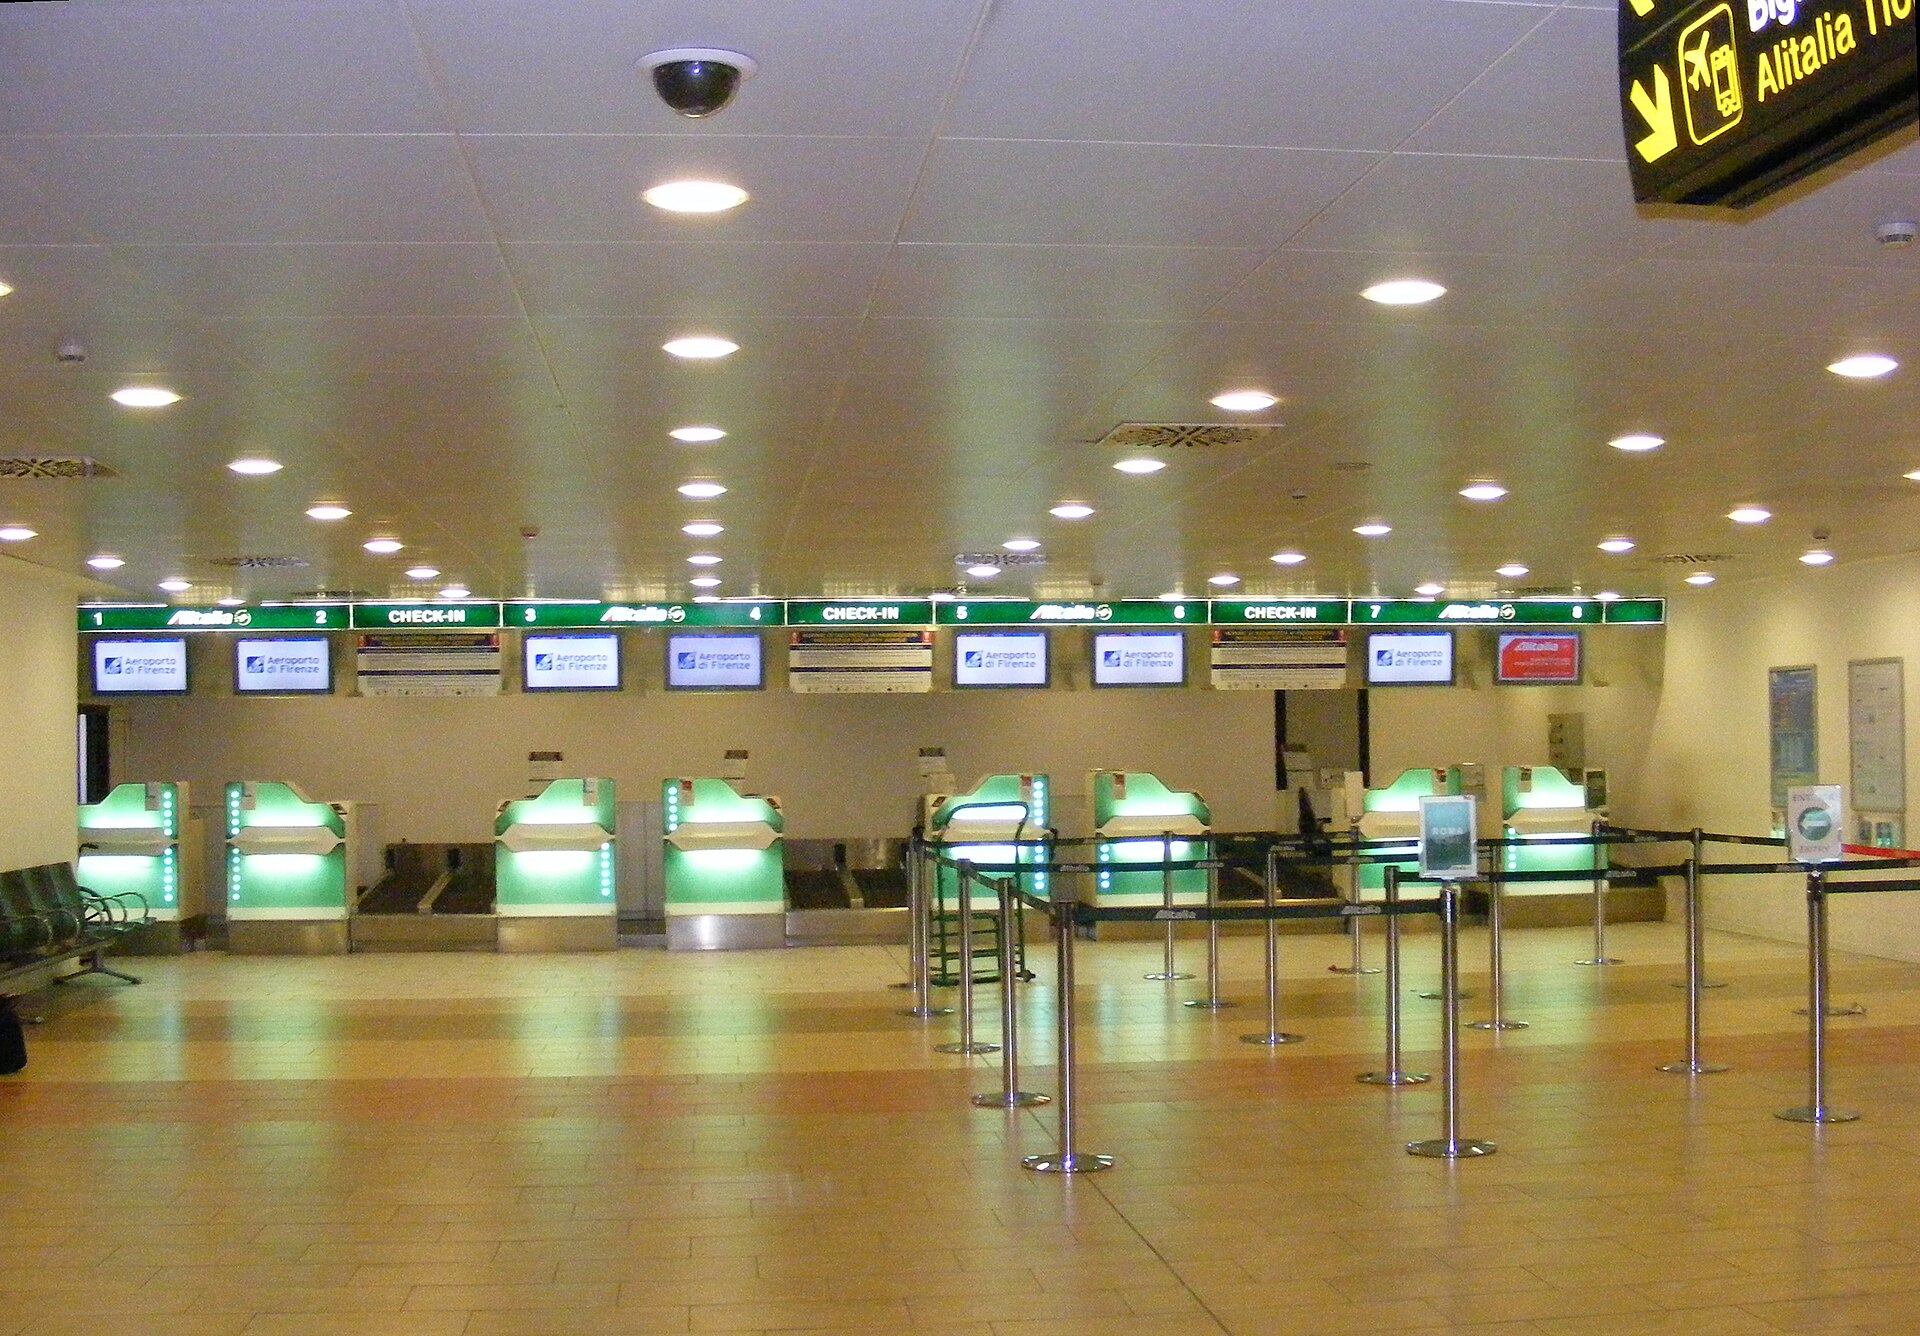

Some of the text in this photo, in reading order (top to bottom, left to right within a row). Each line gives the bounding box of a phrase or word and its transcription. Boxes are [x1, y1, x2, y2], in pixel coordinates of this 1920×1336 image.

[1758, 12, 1856, 102] Alitalia
[167, 609, 234, 626] Alitalia
[315, 611, 327, 624] 2
[388, 609, 466, 623] CHECK-IN
[525, 608, 536, 622] 3
[600, 606, 668, 622] Alitalia
[749, 607, 761, 621] 4
[822, 606, 899, 620] CHECK-IN
[956, 606, 968, 620] 5
[1030, 605, 1095, 620] Alitalia
[1173, 605, 1185, 619] 6
[1244, 606, 1317, 620] CHECK-IN
[1370, 605, 1381, 619] 7
[1572, 605, 1583, 619] 8
[94, 612, 103, 626] 1
[555, 653, 608, 663] Aeroporto
[699, 652, 750, 662] Aeroporto
[985, 651, 1036, 661] Aeroporto
[1124, 650, 1174, 660] Aeroporto
[1396, 649, 1443, 659] Aeroporto
[125, 657, 177, 667] Aeroporto
[267, 656, 319, 666] Aeroporto
[556, 661, 608, 671] di Firenze
[699, 660, 750, 670] di Firenze
[985, 659, 1037, 668] di Firenze
[1123, 658, 1174, 668] di Firenze
[1395, 657, 1443, 667] di Firenze
[125, 665, 177, 675] di Firenze
[267, 664, 319, 674] di Firenze
